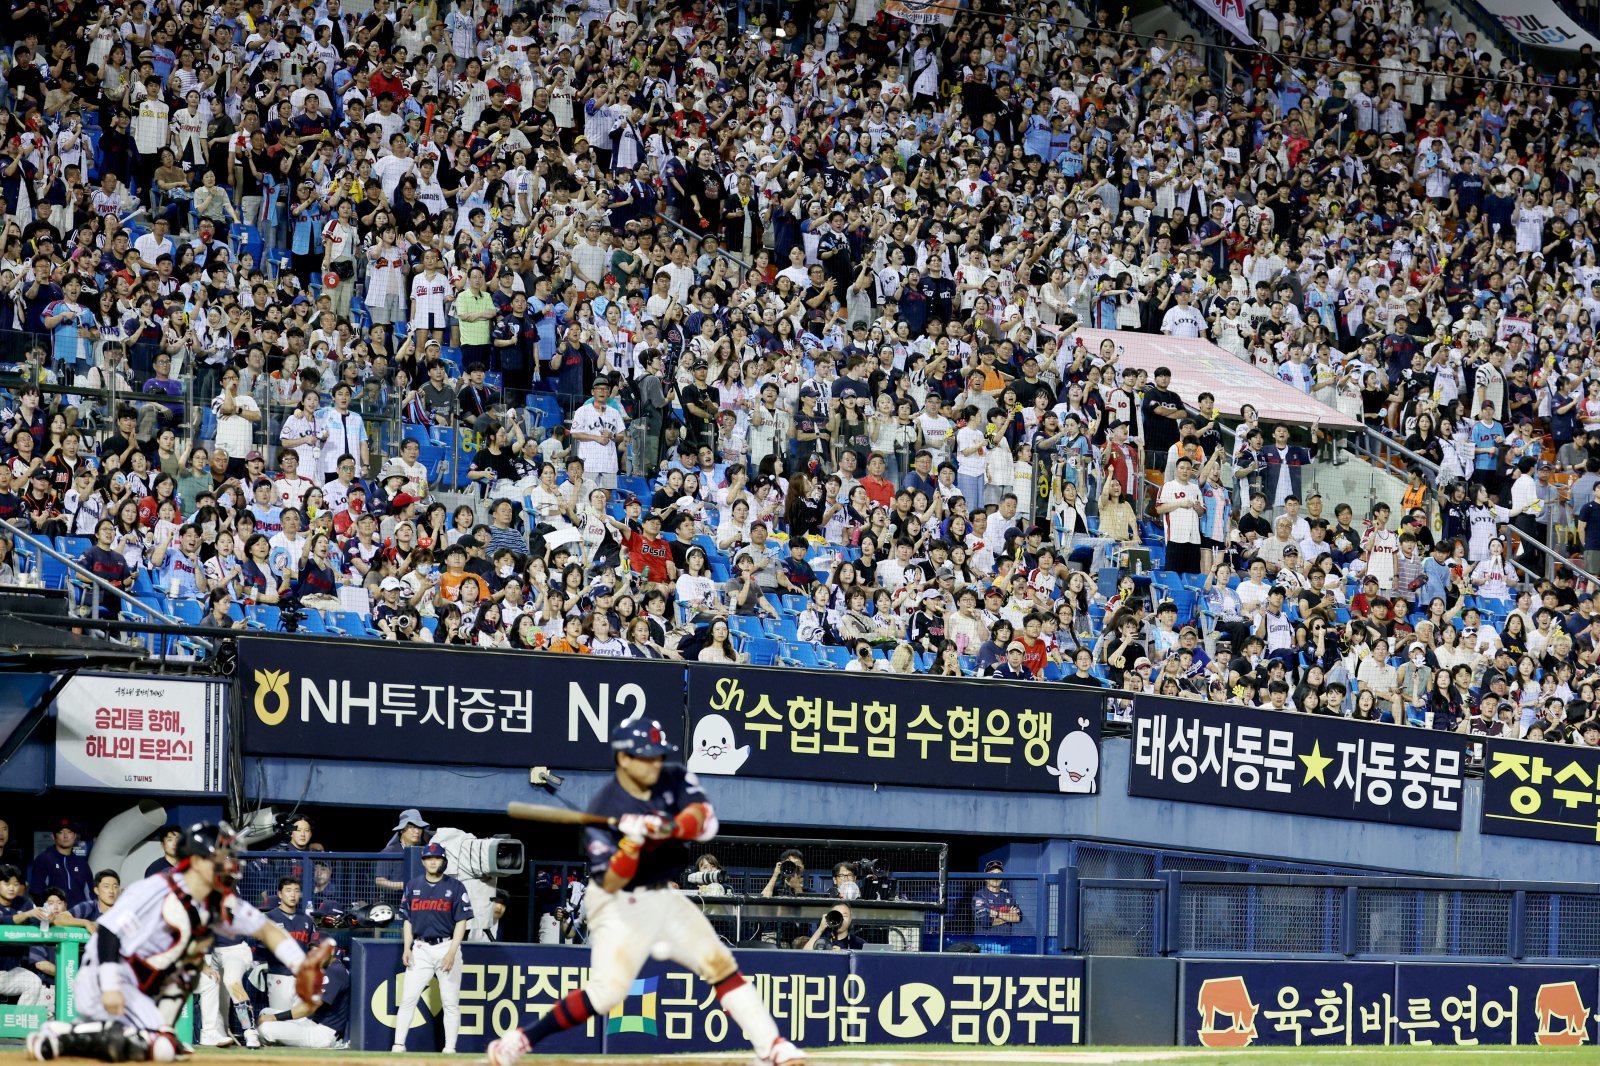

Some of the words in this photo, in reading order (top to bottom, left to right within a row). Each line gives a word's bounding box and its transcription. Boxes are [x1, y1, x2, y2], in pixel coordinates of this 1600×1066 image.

[1173, 317, 1199, 327] LOTTE
[301, 677, 533, 733] NH투자증권
[568, 681, 647, 743] N2
[709, 677, 746, 712] Sh
[95, 707, 143, 731] 승리를
[148, 709, 185, 735] 향해,
[744, 694, 897, 759] 수협보험
[906, 704, 1053, 767] 수협은행
[86, 735, 134, 759] 하나의
[139, 738, 193, 762] 트윈스!
[1135, 714, 1295, 794] 태성자동문
[1333, 738, 1462, 811] 자동중문
[133, 775, 153, 783] TWINS
[1488, 751, 1600, 841] 장수
[411, 898, 452, 911] Giants
[4, 1013, 39, 1029] 트래블
[951, 975, 1081, 1046] 금강주택
